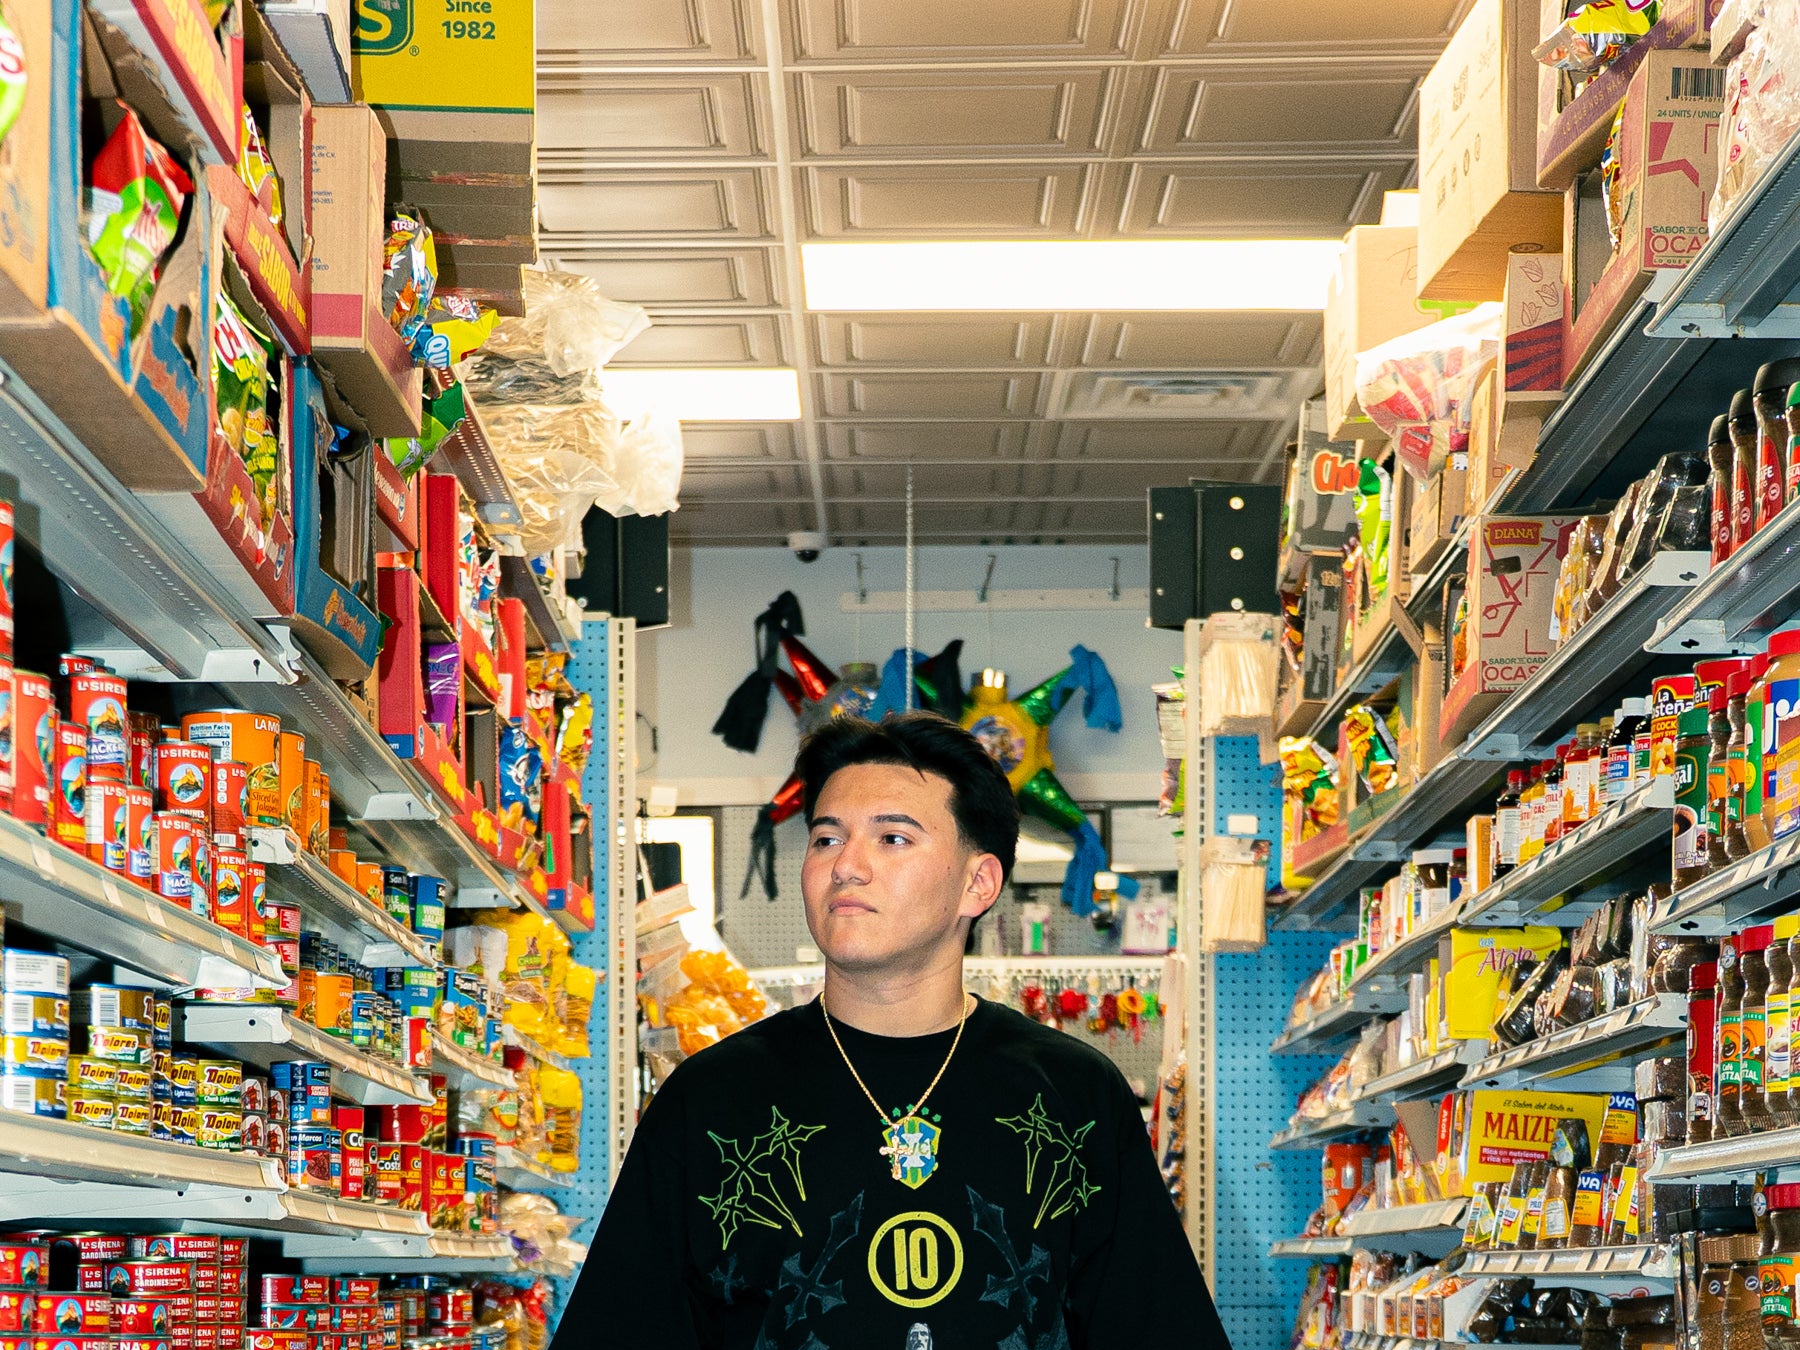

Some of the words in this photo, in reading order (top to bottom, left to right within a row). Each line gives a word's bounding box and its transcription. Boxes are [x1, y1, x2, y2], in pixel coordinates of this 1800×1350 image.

[442, 20, 496, 40] 1982
[1668, 109, 1689, 118] UNITS
[1652, 225, 1687, 235] SABOR
[1494, 526, 1535, 540] DIANA
[1488, 657, 1517, 665] SABOR
[1657, 691, 1669, 703] La
[169, 749, 210, 760] SIRENA
[92, 1034, 137, 1049] Dolores
[298, 1133, 322, 1142] Marcos
[90, 1240, 121, 1249] SIRENA
[188, 1240, 216, 1249] SIRENA
[81, 1251, 112, 1260] SARDINES
[892, 1226, 938, 1291] 10
[145, 1267, 181, 1277] SIRENA
[134, 1278, 169, 1287] SARDINES
